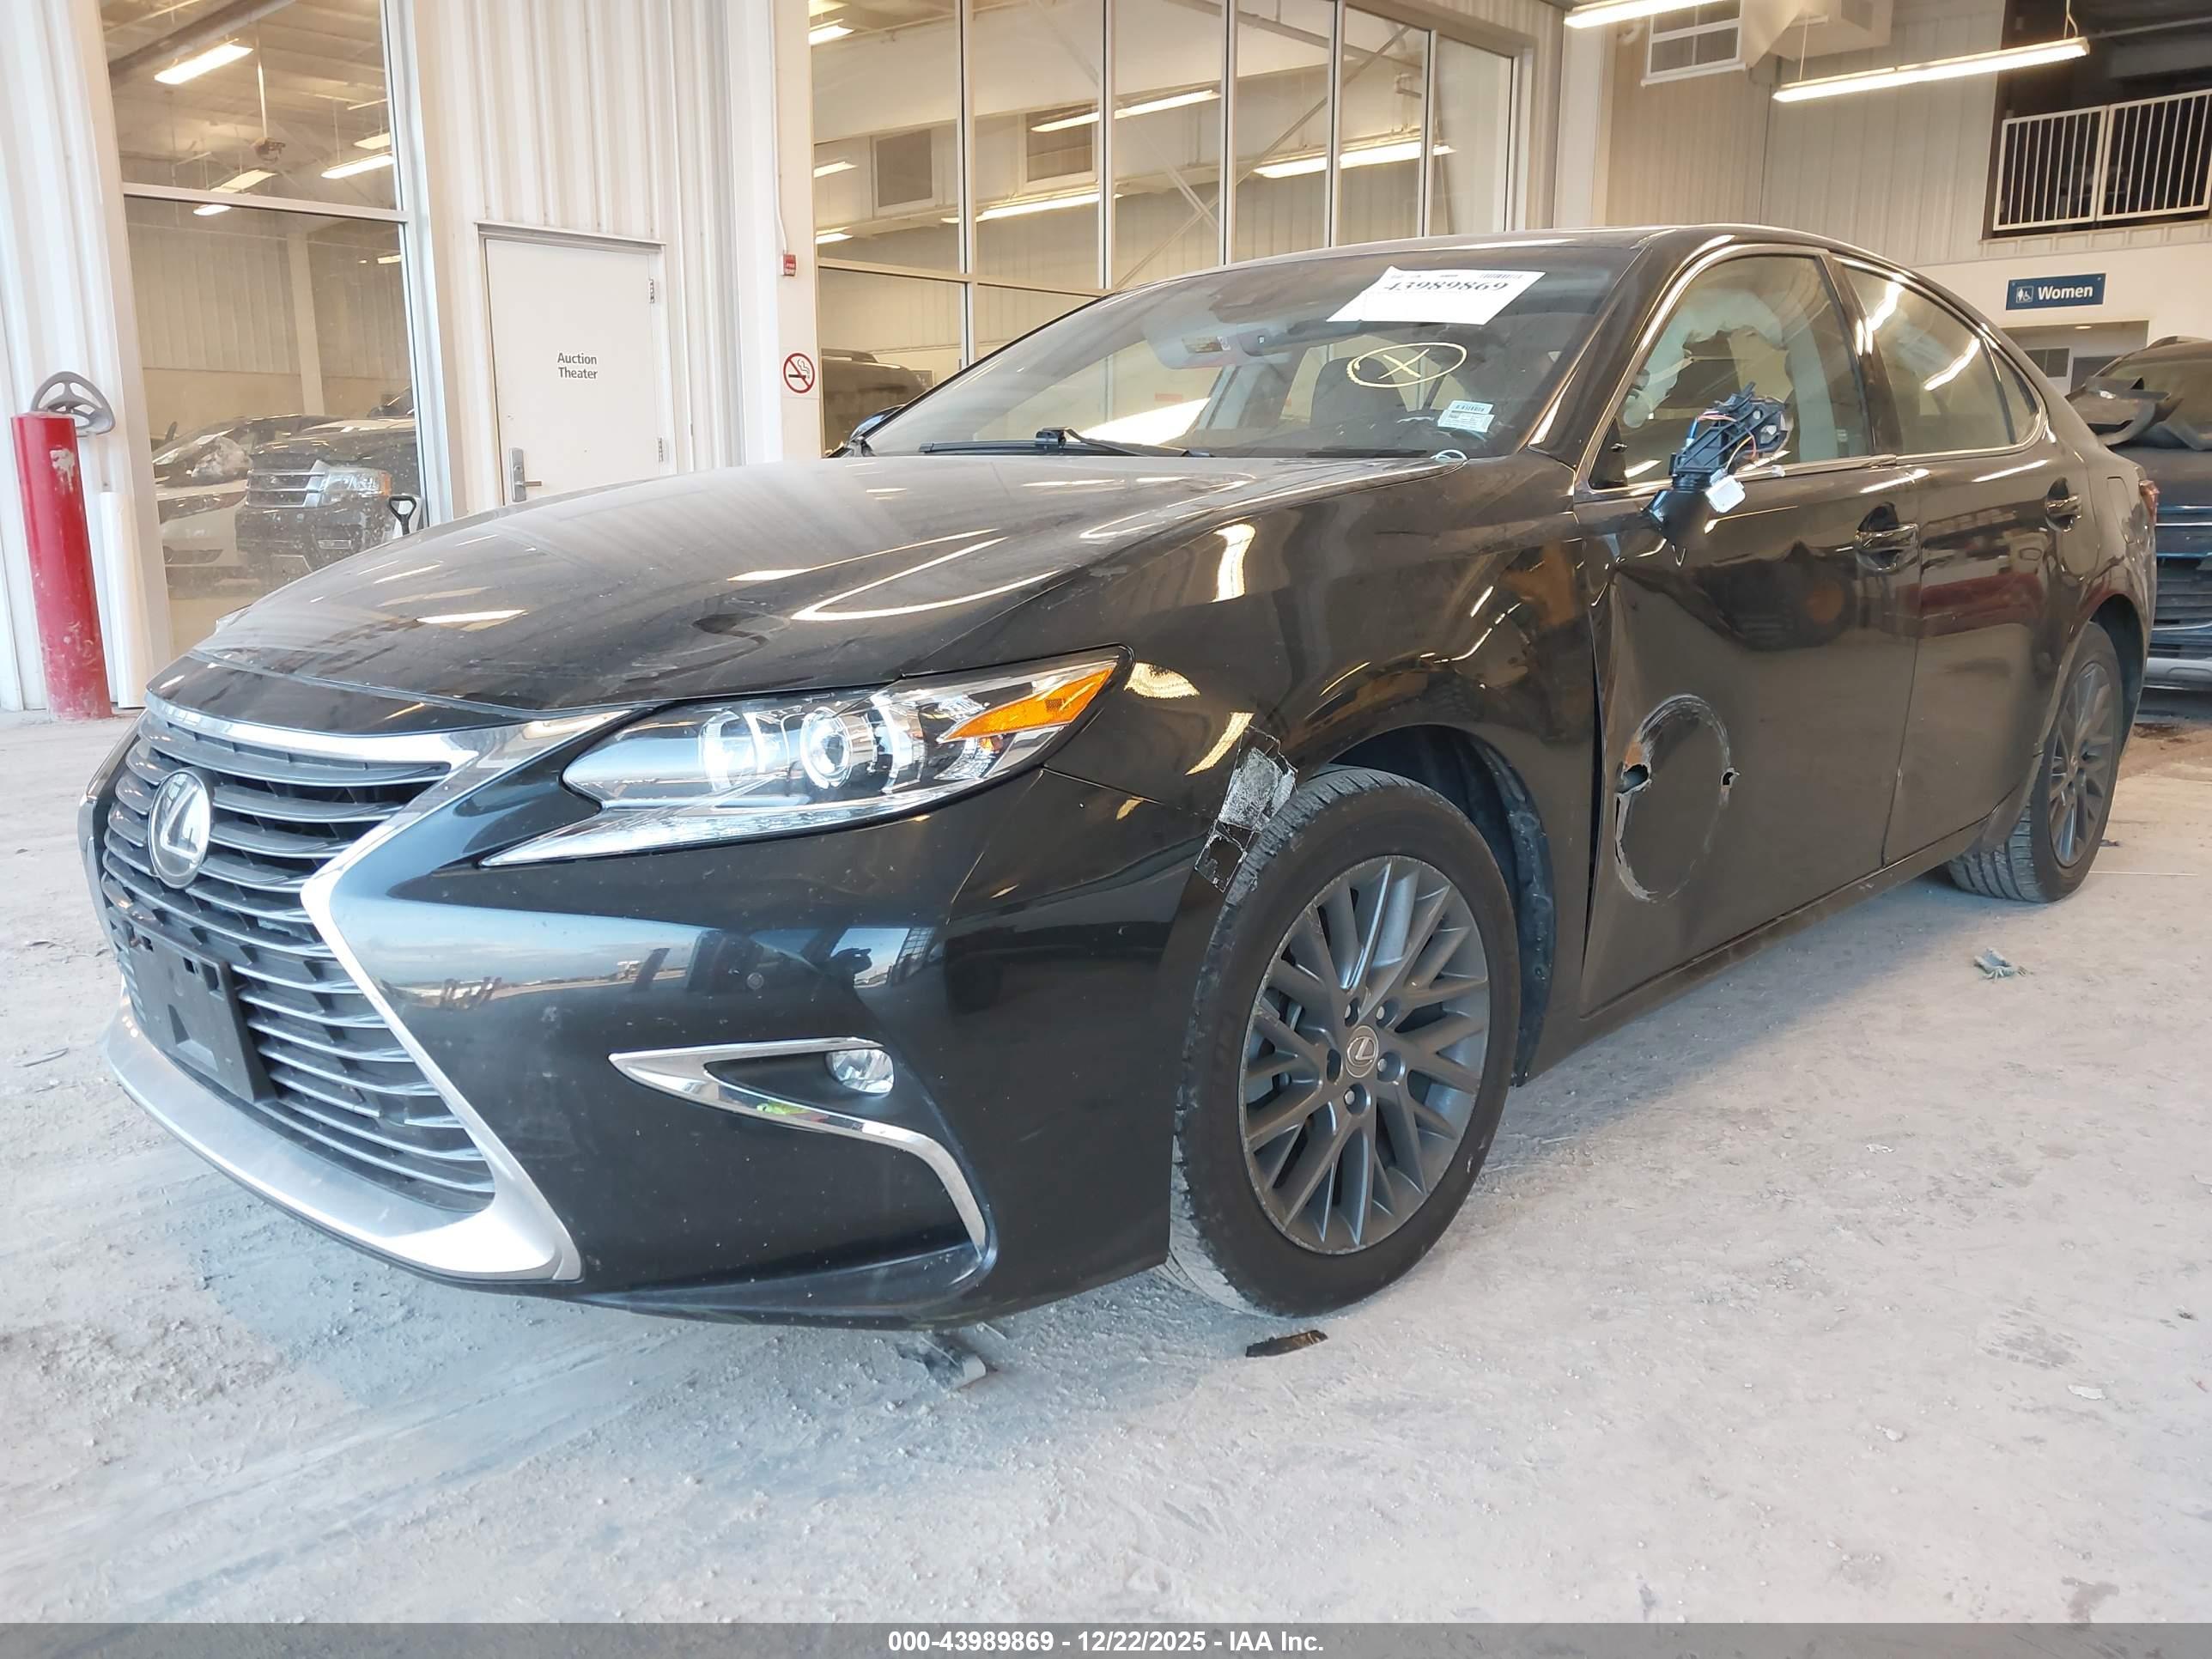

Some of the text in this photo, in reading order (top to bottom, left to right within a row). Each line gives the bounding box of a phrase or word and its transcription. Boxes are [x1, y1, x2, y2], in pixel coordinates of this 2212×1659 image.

[2038, 285, 2094, 301] Women
[557, 352, 598, 365] Auction
[557, 366, 599, 380] Theater
